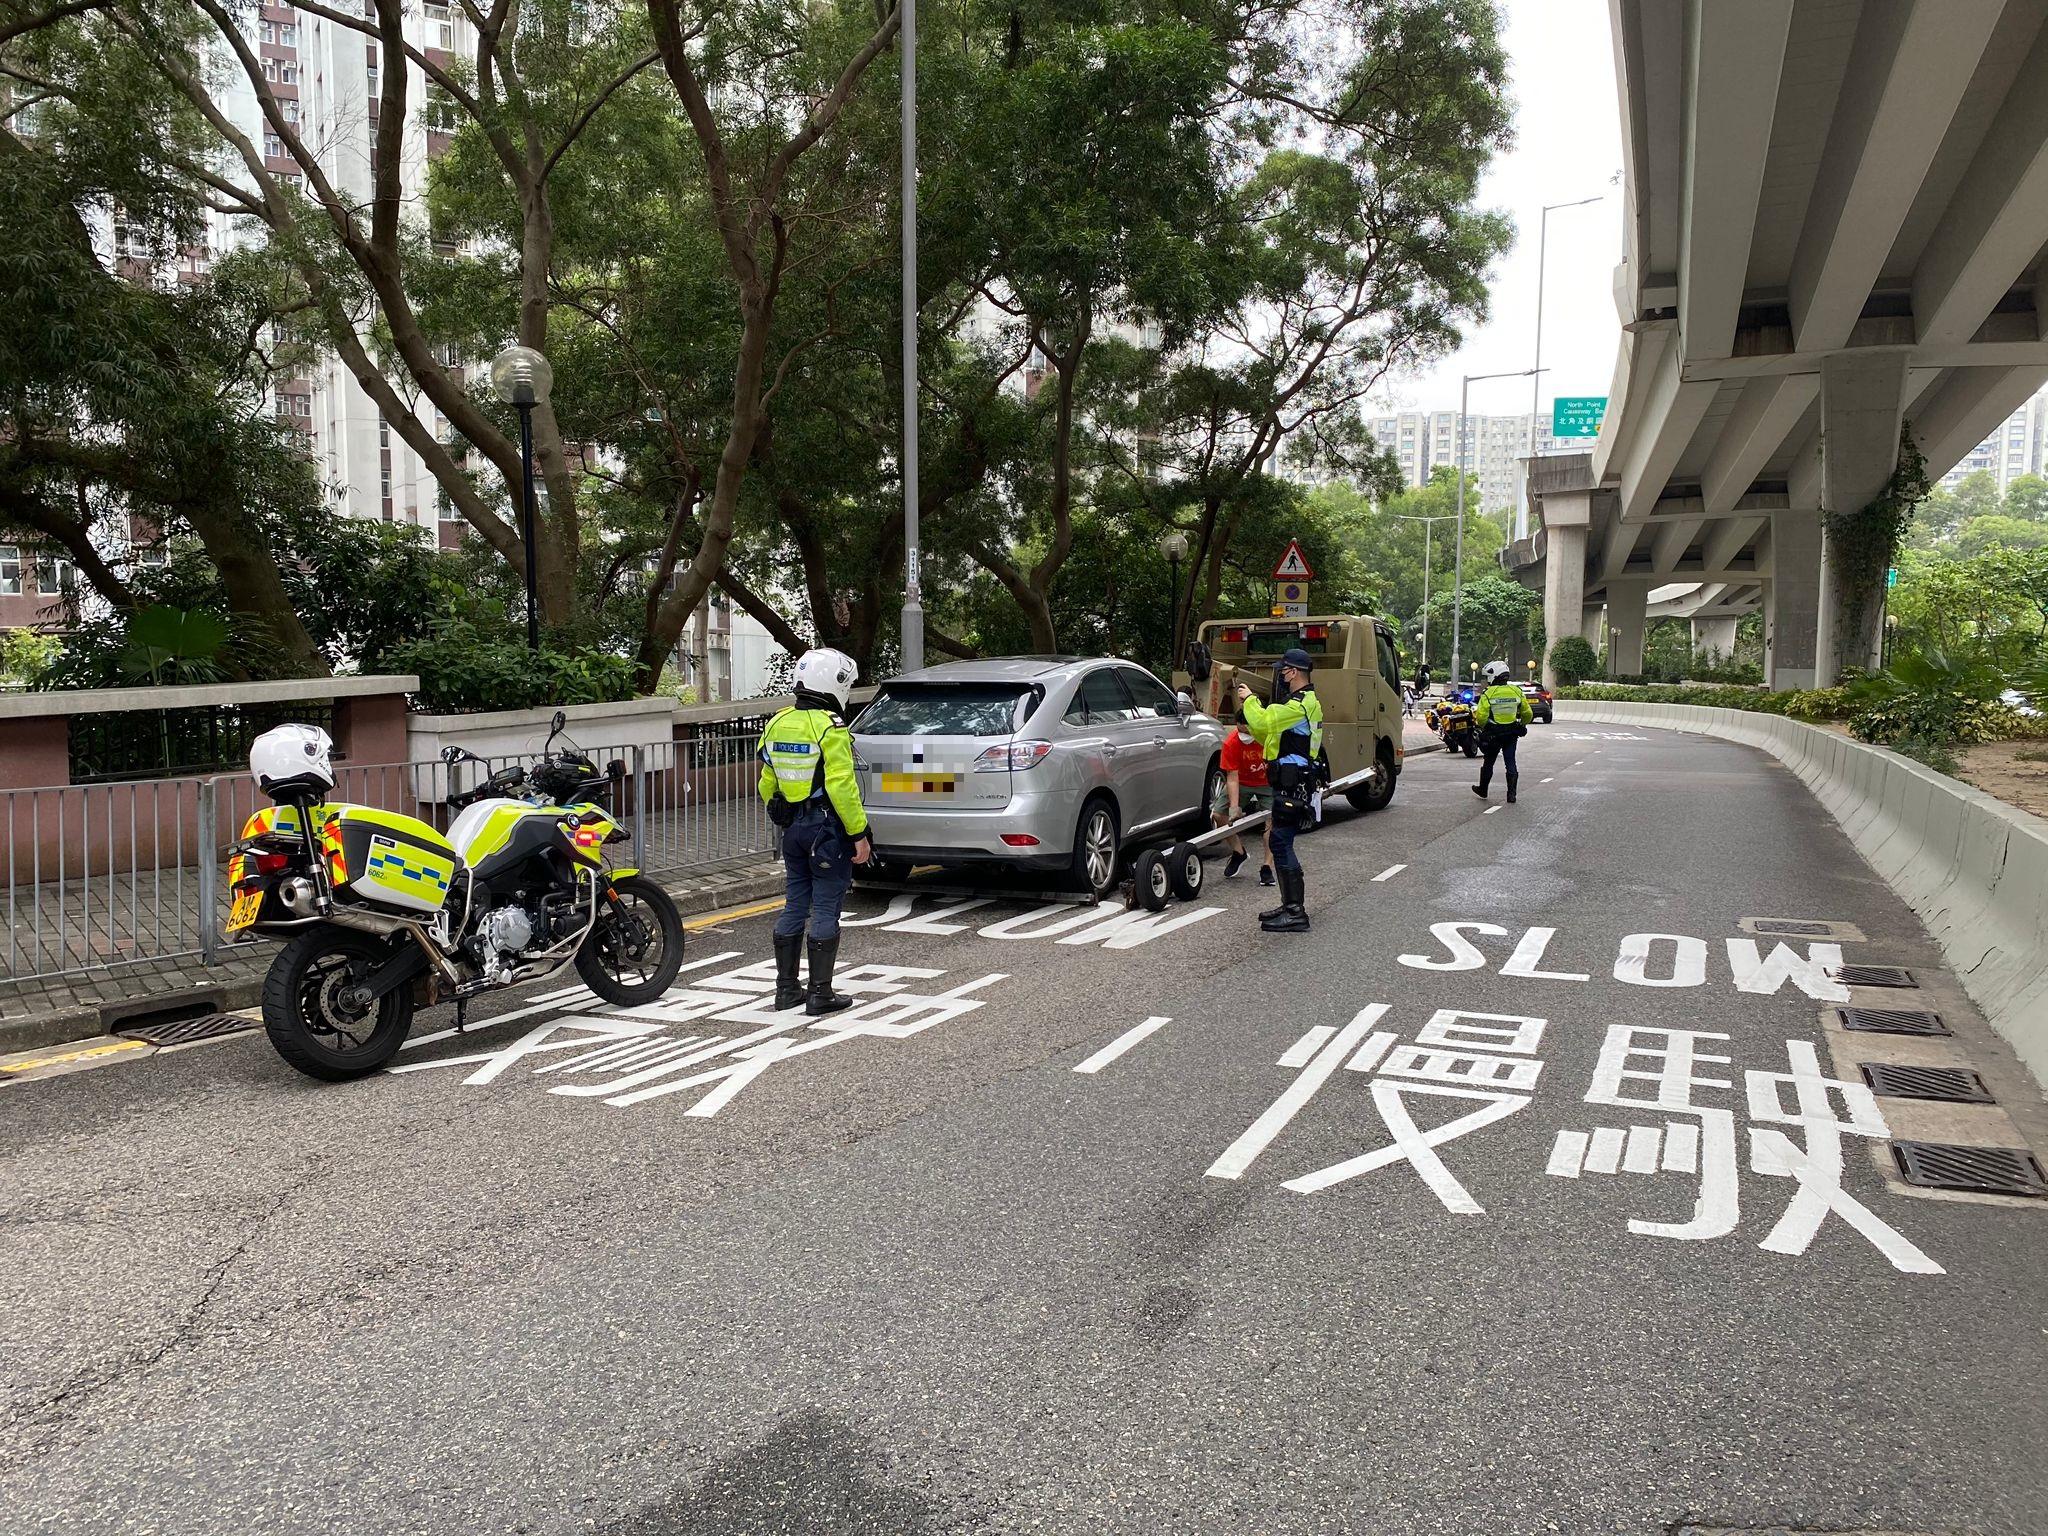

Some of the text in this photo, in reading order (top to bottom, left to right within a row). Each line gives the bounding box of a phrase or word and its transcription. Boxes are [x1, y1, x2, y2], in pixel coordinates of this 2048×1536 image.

[1285, 605, 1299, 613] End
[778, 743, 799, 752] POLICE
[239, 895, 255, 914] AM
[228, 906, 257, 928] 6062
[1397, 921, 1853, 1004] SLOW
[1204, 1002, 1947, 1276] 慢駛
